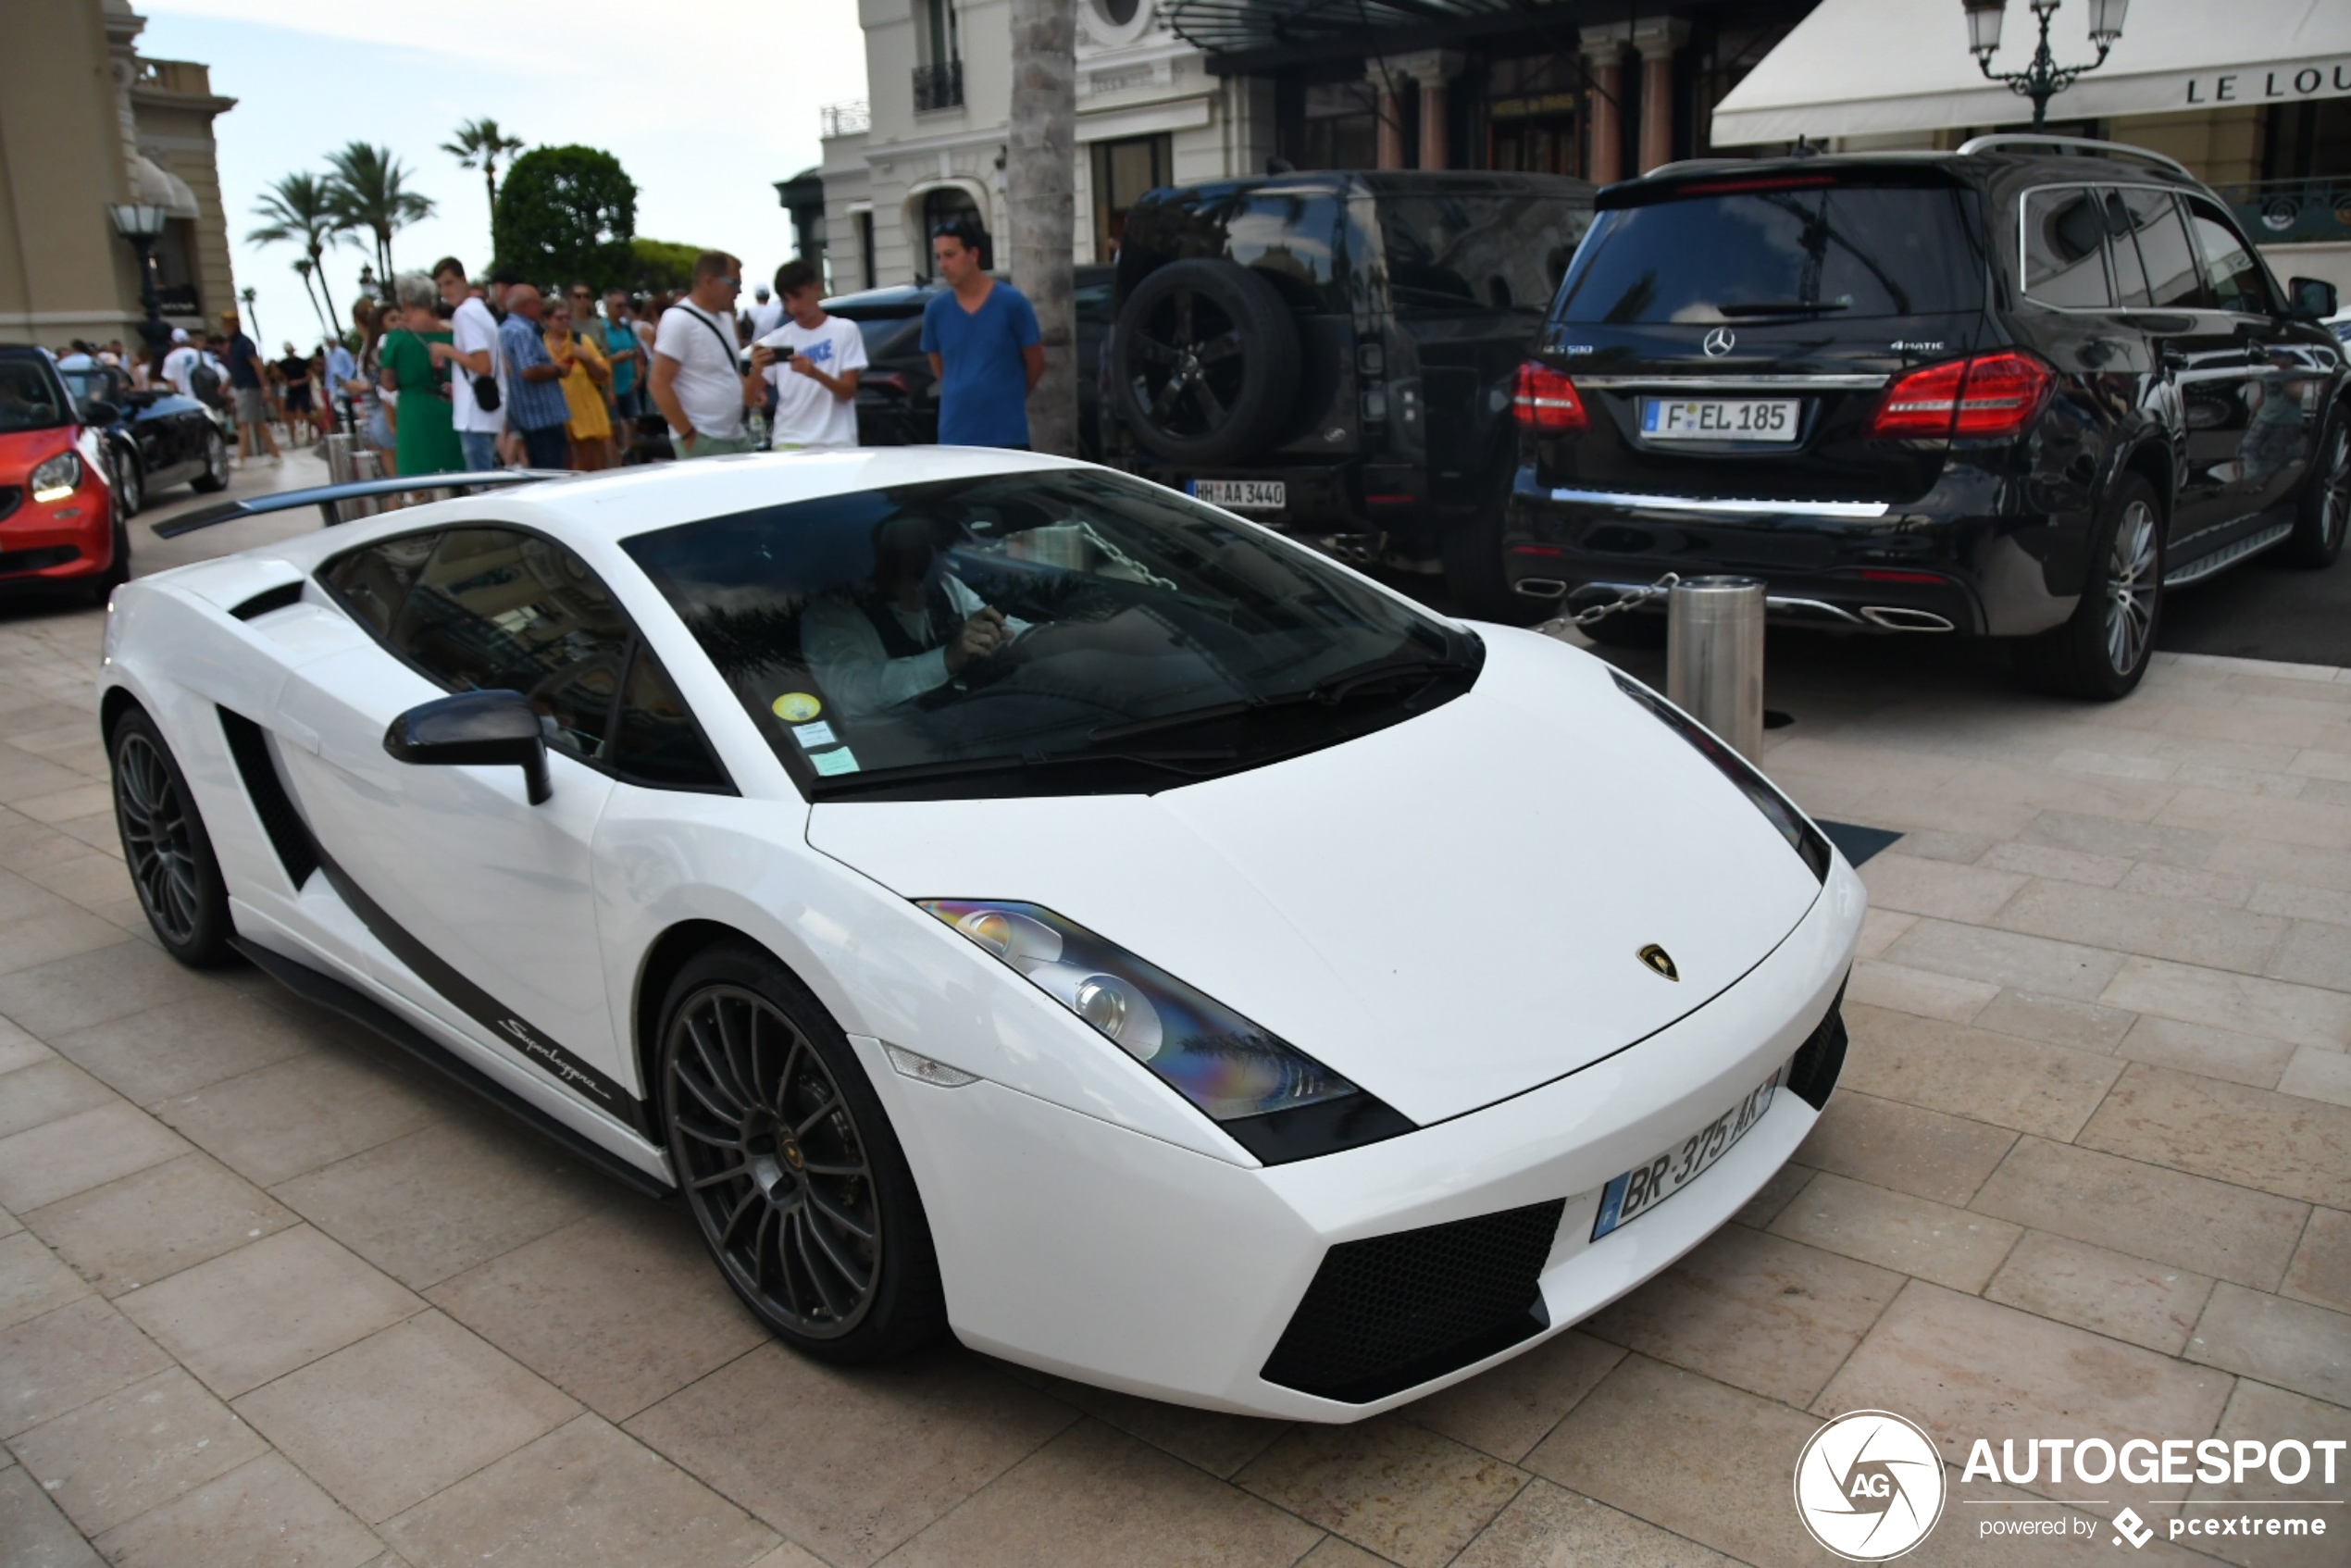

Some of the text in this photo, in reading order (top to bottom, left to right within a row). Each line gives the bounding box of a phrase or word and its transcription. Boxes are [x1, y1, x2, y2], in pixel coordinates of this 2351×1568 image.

[2186, 75, 2237, 105] LE
[1667, 404, 1786, 430] F EL 185
[1195, 482, 1283, 504] HH AA 3440
